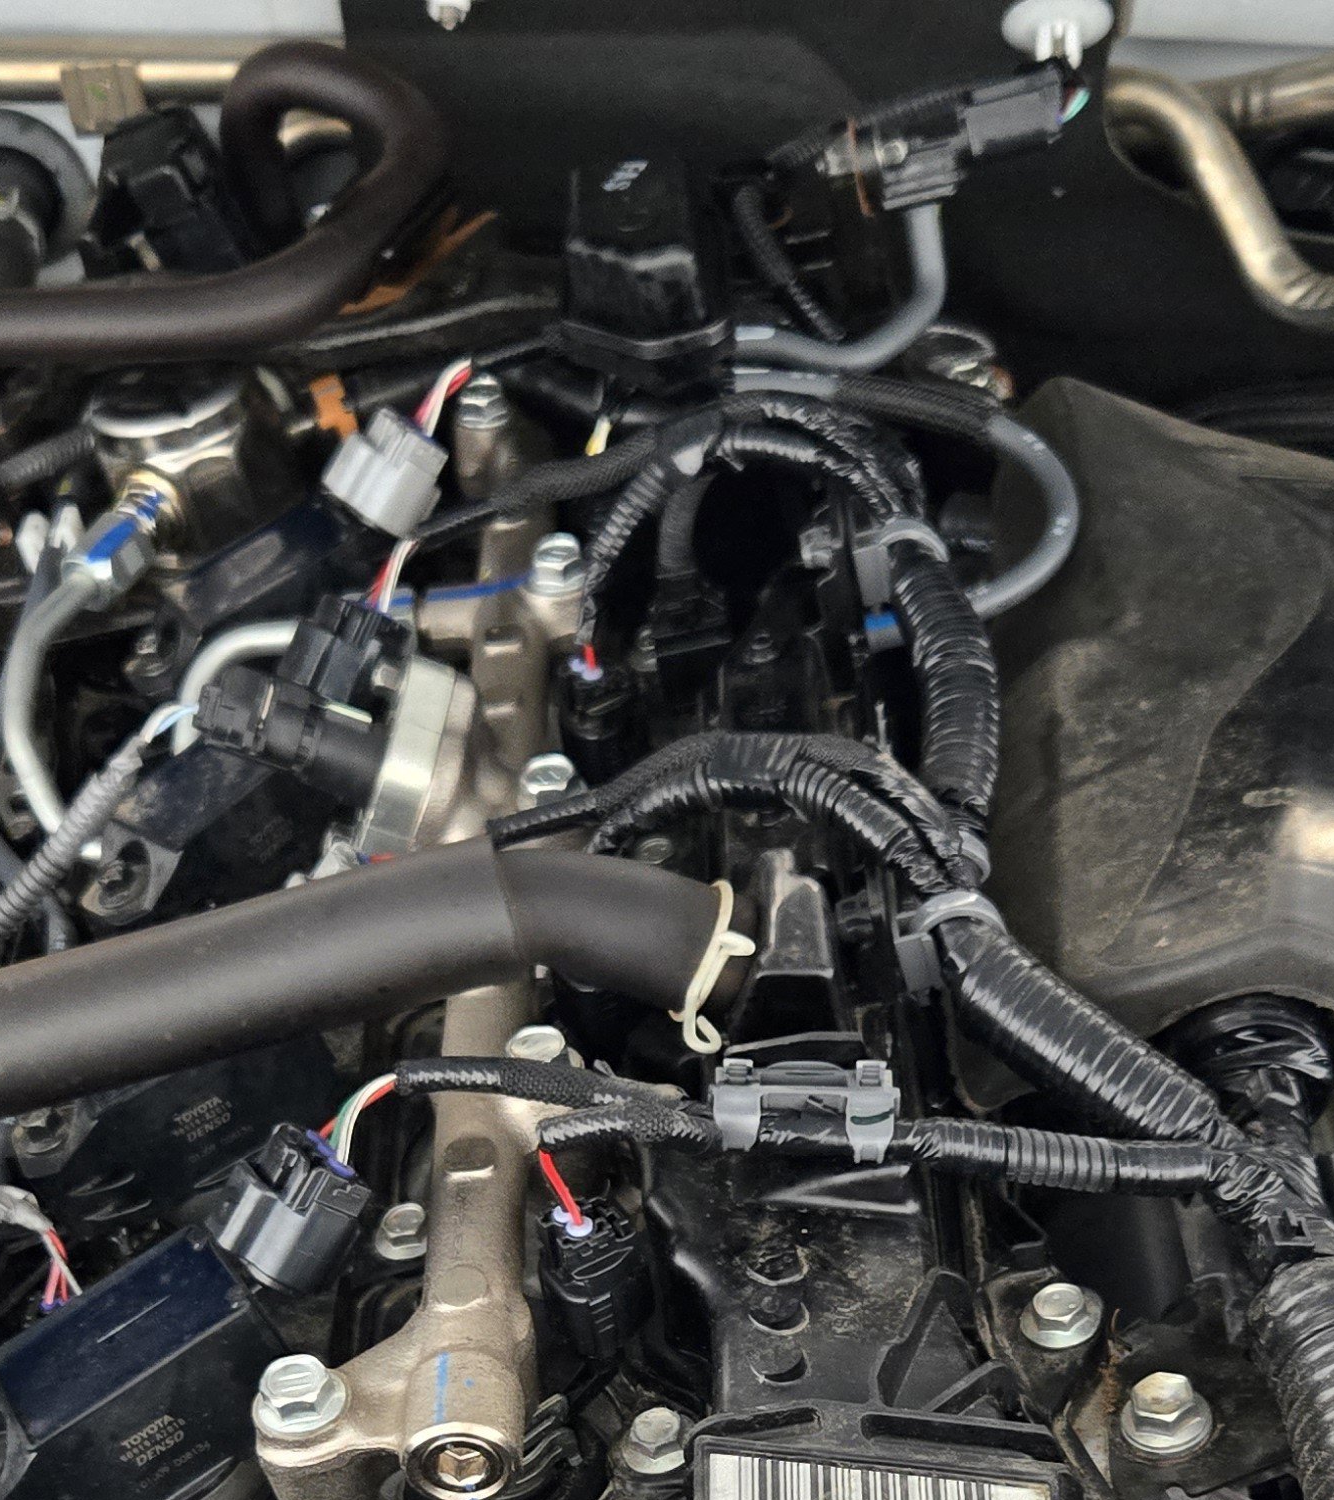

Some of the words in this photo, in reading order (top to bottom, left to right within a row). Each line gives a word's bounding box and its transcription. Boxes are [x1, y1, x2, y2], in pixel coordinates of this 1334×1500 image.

[172, 1096, 223, 1125] TOYOTA
[187, 1112, 231, 1142] DENSO
[120, 1414, 175, 1449] TOYOTA
[136, 1430, 185, 1467] DENSO
